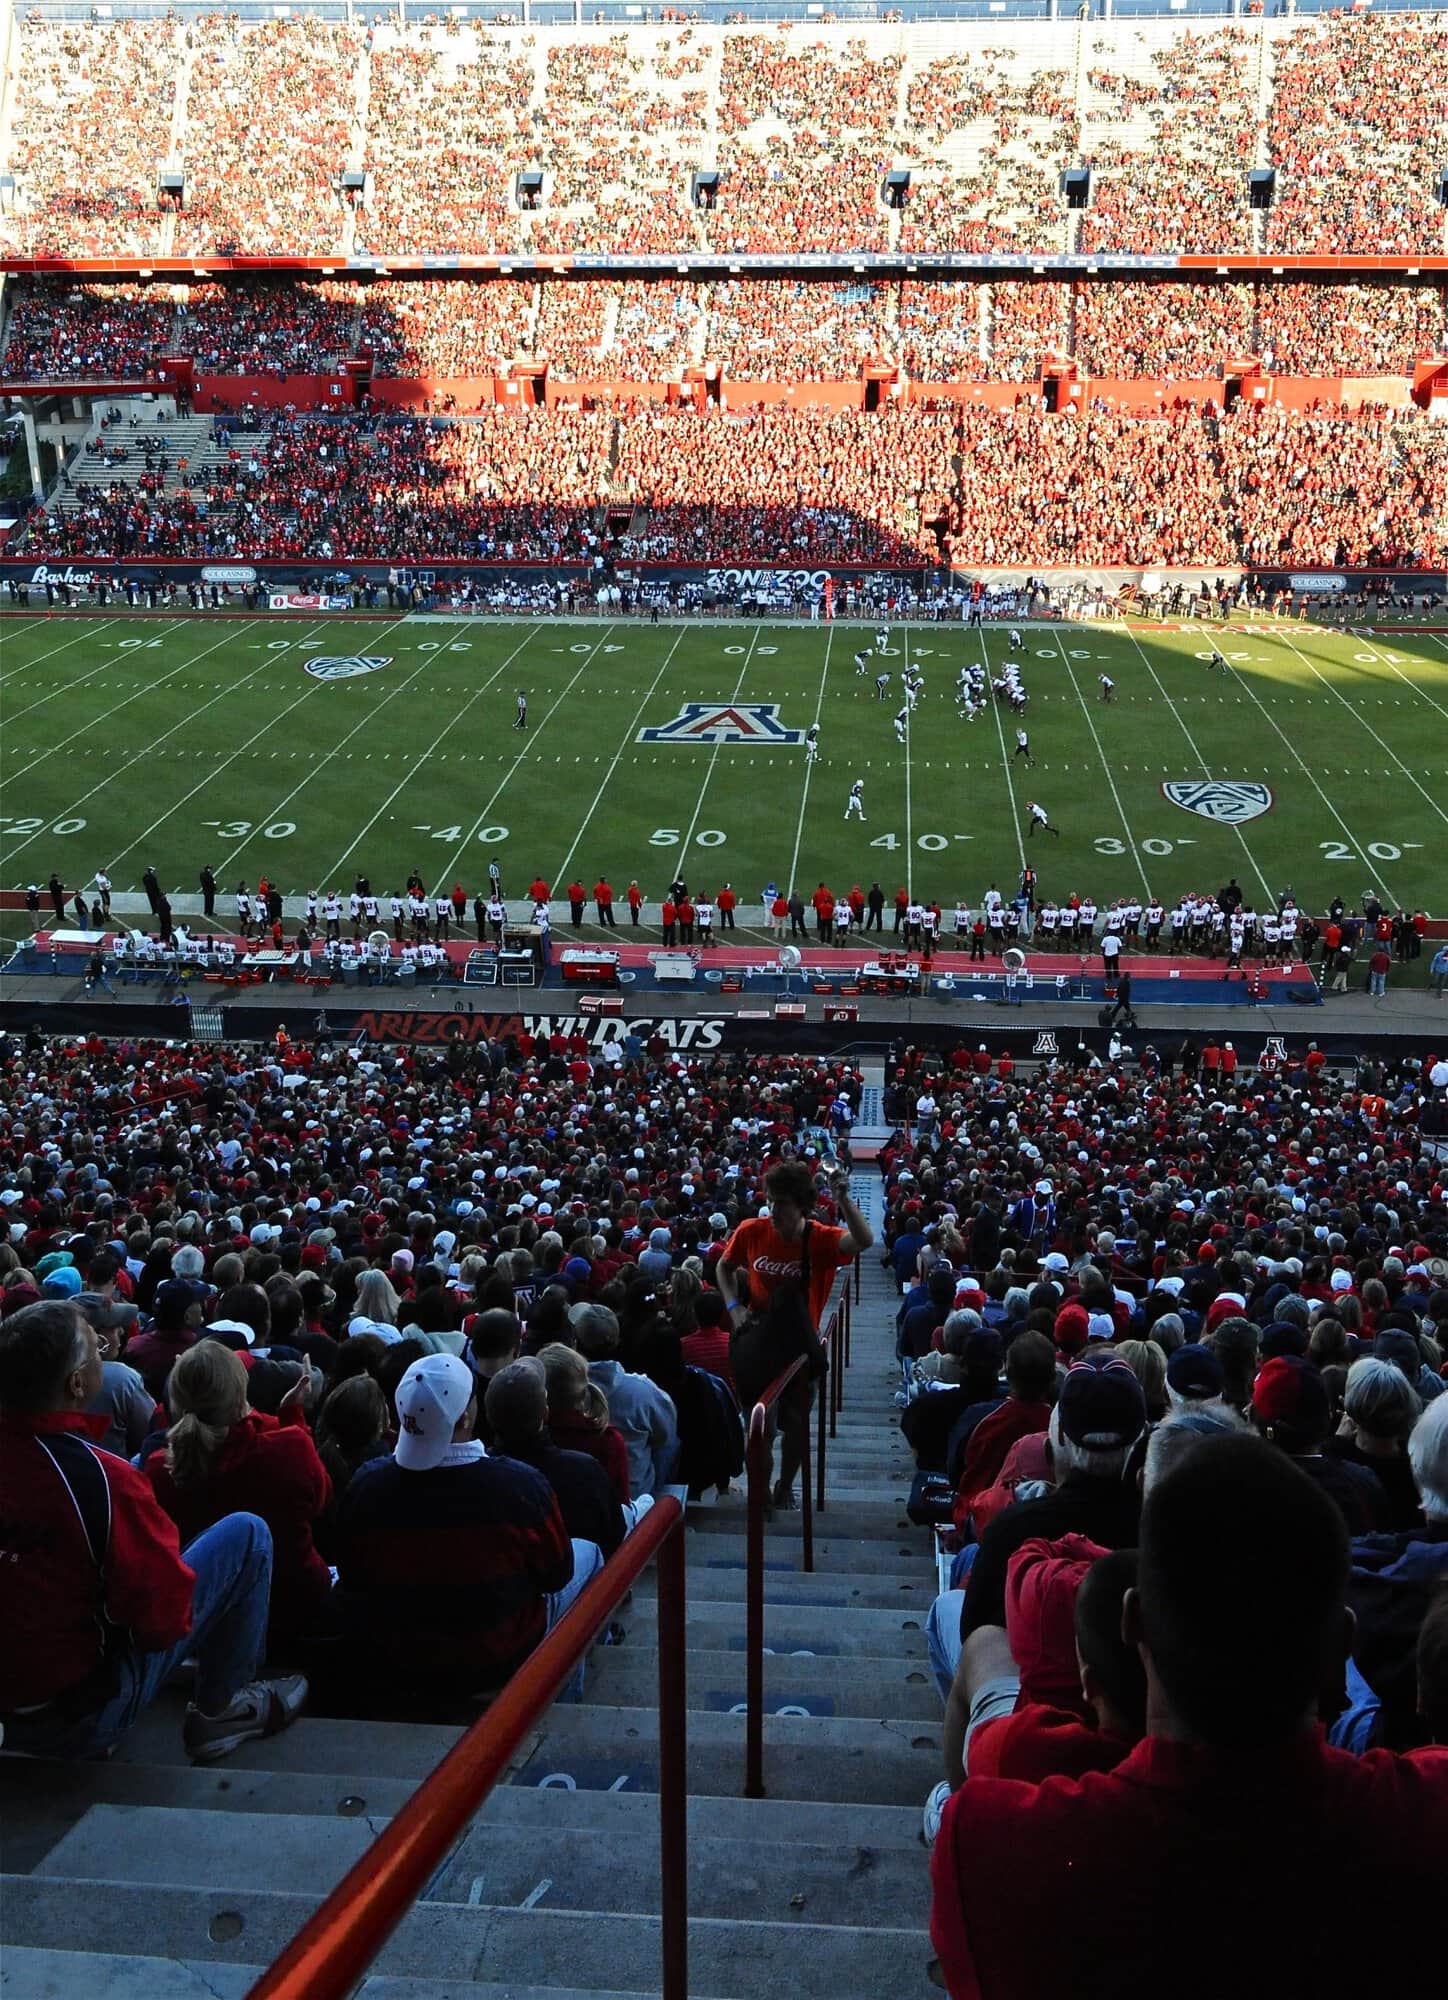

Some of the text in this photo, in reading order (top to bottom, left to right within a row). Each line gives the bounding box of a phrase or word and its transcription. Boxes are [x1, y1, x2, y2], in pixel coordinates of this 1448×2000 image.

[31, 565, 94, 583] Bashas'
[723, 646, 779, 655] 50
[1036, 650, 1091, 659] 30
[635, 703, 806, 745] A
[1205, 802, 1249, 815] 12
[3, 818, 87, 835] 20
[217, 822, 297, 838] 30
[431, 826, 510, 843] 40
[648, 829, 727, 847] 50
[870, 833, 949, 851] 40
[1094, 838, 1174, 856] 30
[1319, 842, 1401, 860] 20
[348, 1013, 725, 1048] ARIZONA WILDCATS
[1033, 1032, 1059, 1054] A
[1265, 1059, 1276, 1069] 13
[753, 1255, 801, 1280] Coca-Co
